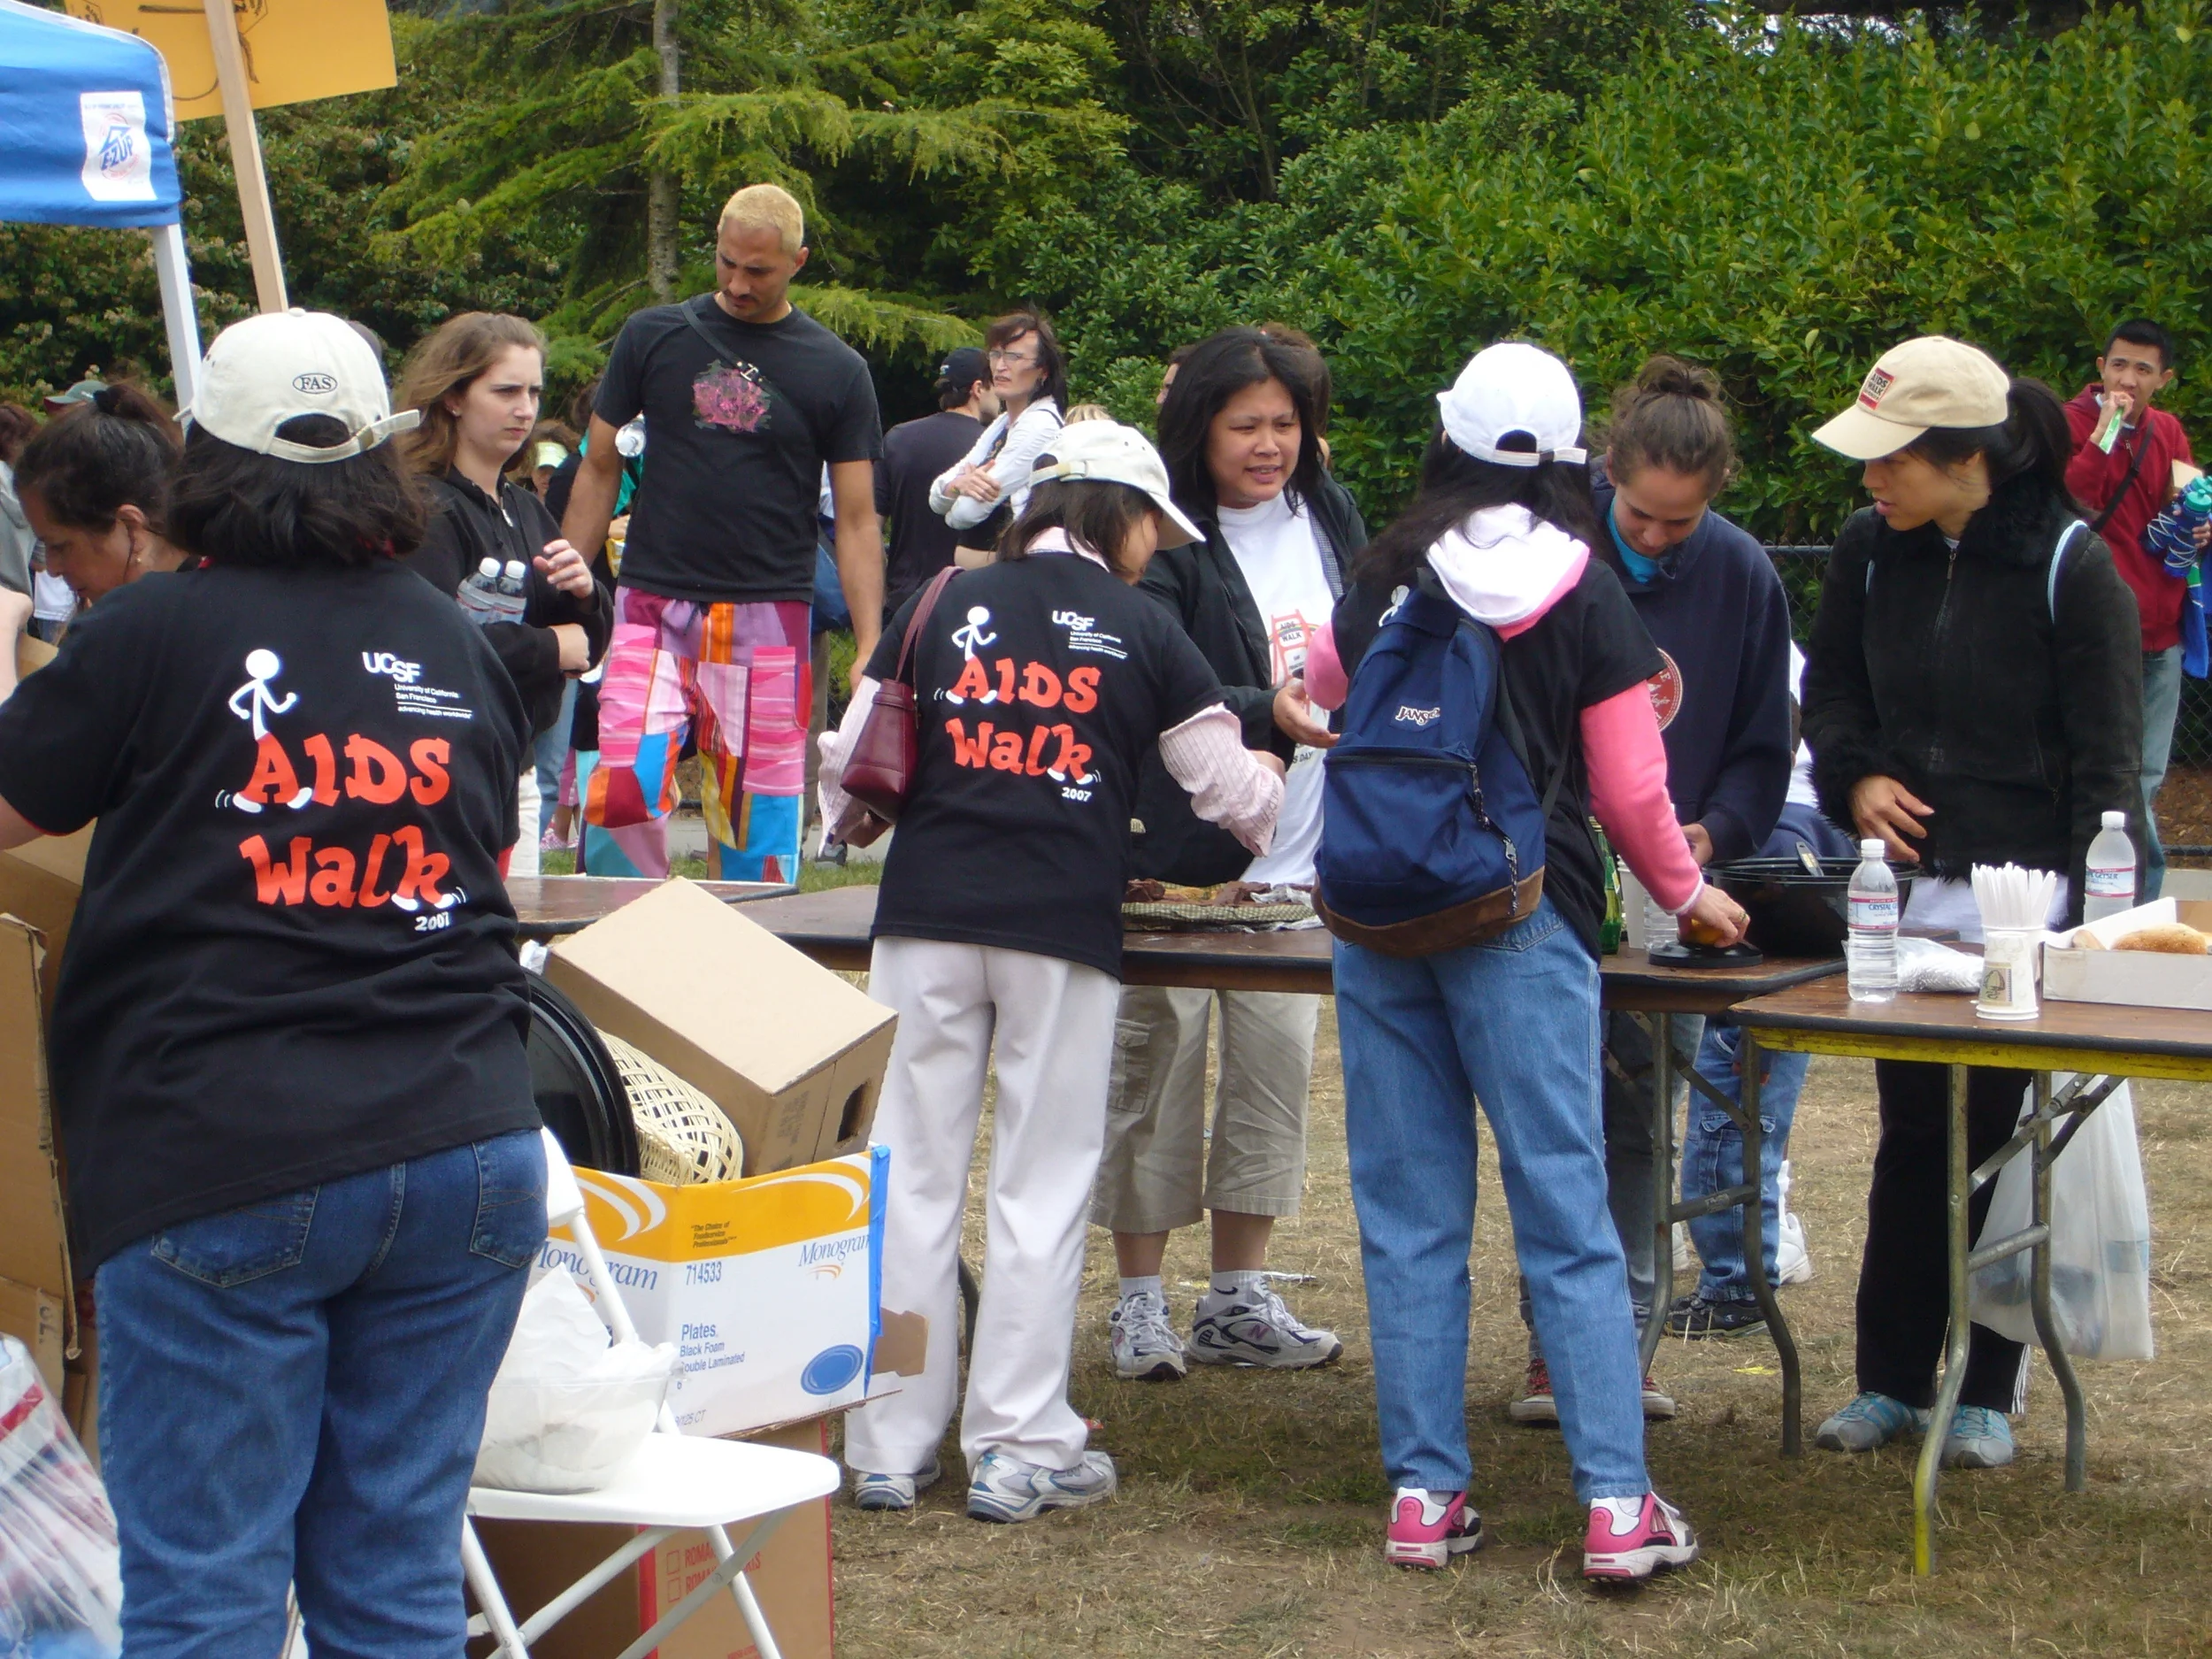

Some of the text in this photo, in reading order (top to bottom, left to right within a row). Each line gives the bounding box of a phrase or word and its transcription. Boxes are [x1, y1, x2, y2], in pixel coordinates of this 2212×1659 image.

[301, 377, 332, 389] FAS
[1870, 373, 1889, 388] AIDS
[1052, 611, 1094, 631] UCSF
[1280, 621, 1296, 630] AIDS
[1282, 632, 1302, 642] WALK
[362, 651, 420, 683] UCSF
[394, 683, 424, 694] University
[431, 687, 460, 699] California
[950, 655, 1102, 713] AIDS
[409, 693, 437, 703] Francisco
[945, 718, 1092, 778] Walk
[1299, 751, 1313, 763] DAY
[241, 732, 450, 807] AIDS
[1062, 787, 1091, 802] 2007
[239, 825, 450, 908] Walk
[538, 1240, 657, 1290] onoram
[686, 1261, 722, 1286] 714533
[680, 1341, 725, 1357] Black Foam
[681, 1351, 745, 1372] ouble Laminated
[695, 1409, 706, 1423] CT
[685, 1541, 717, 1568] ROMA
